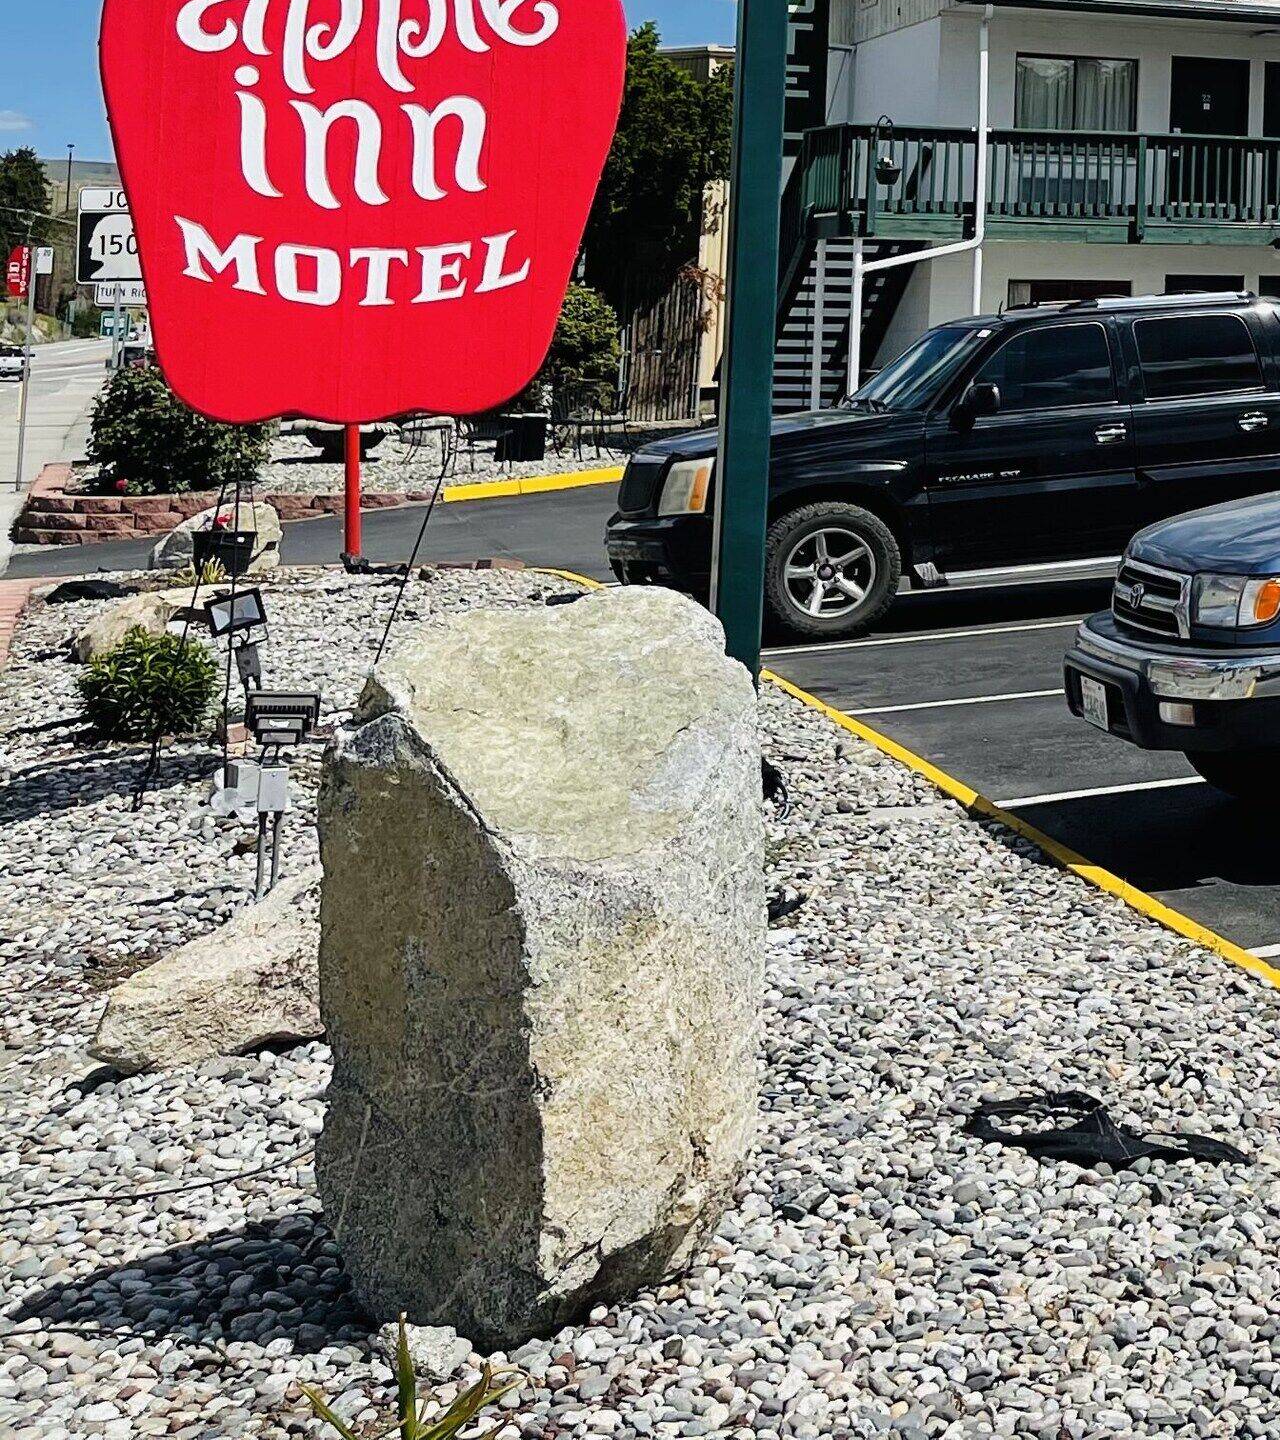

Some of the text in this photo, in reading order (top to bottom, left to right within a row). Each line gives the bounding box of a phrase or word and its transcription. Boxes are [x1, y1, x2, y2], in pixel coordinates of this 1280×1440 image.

[233, 64, 488, 210] inn
[103, 191, 128, 208] JC
[100, 234, 139, 255] 150
[173, 214, 532, 307] MOTEL
[100, 286, 126, 298] TUN
